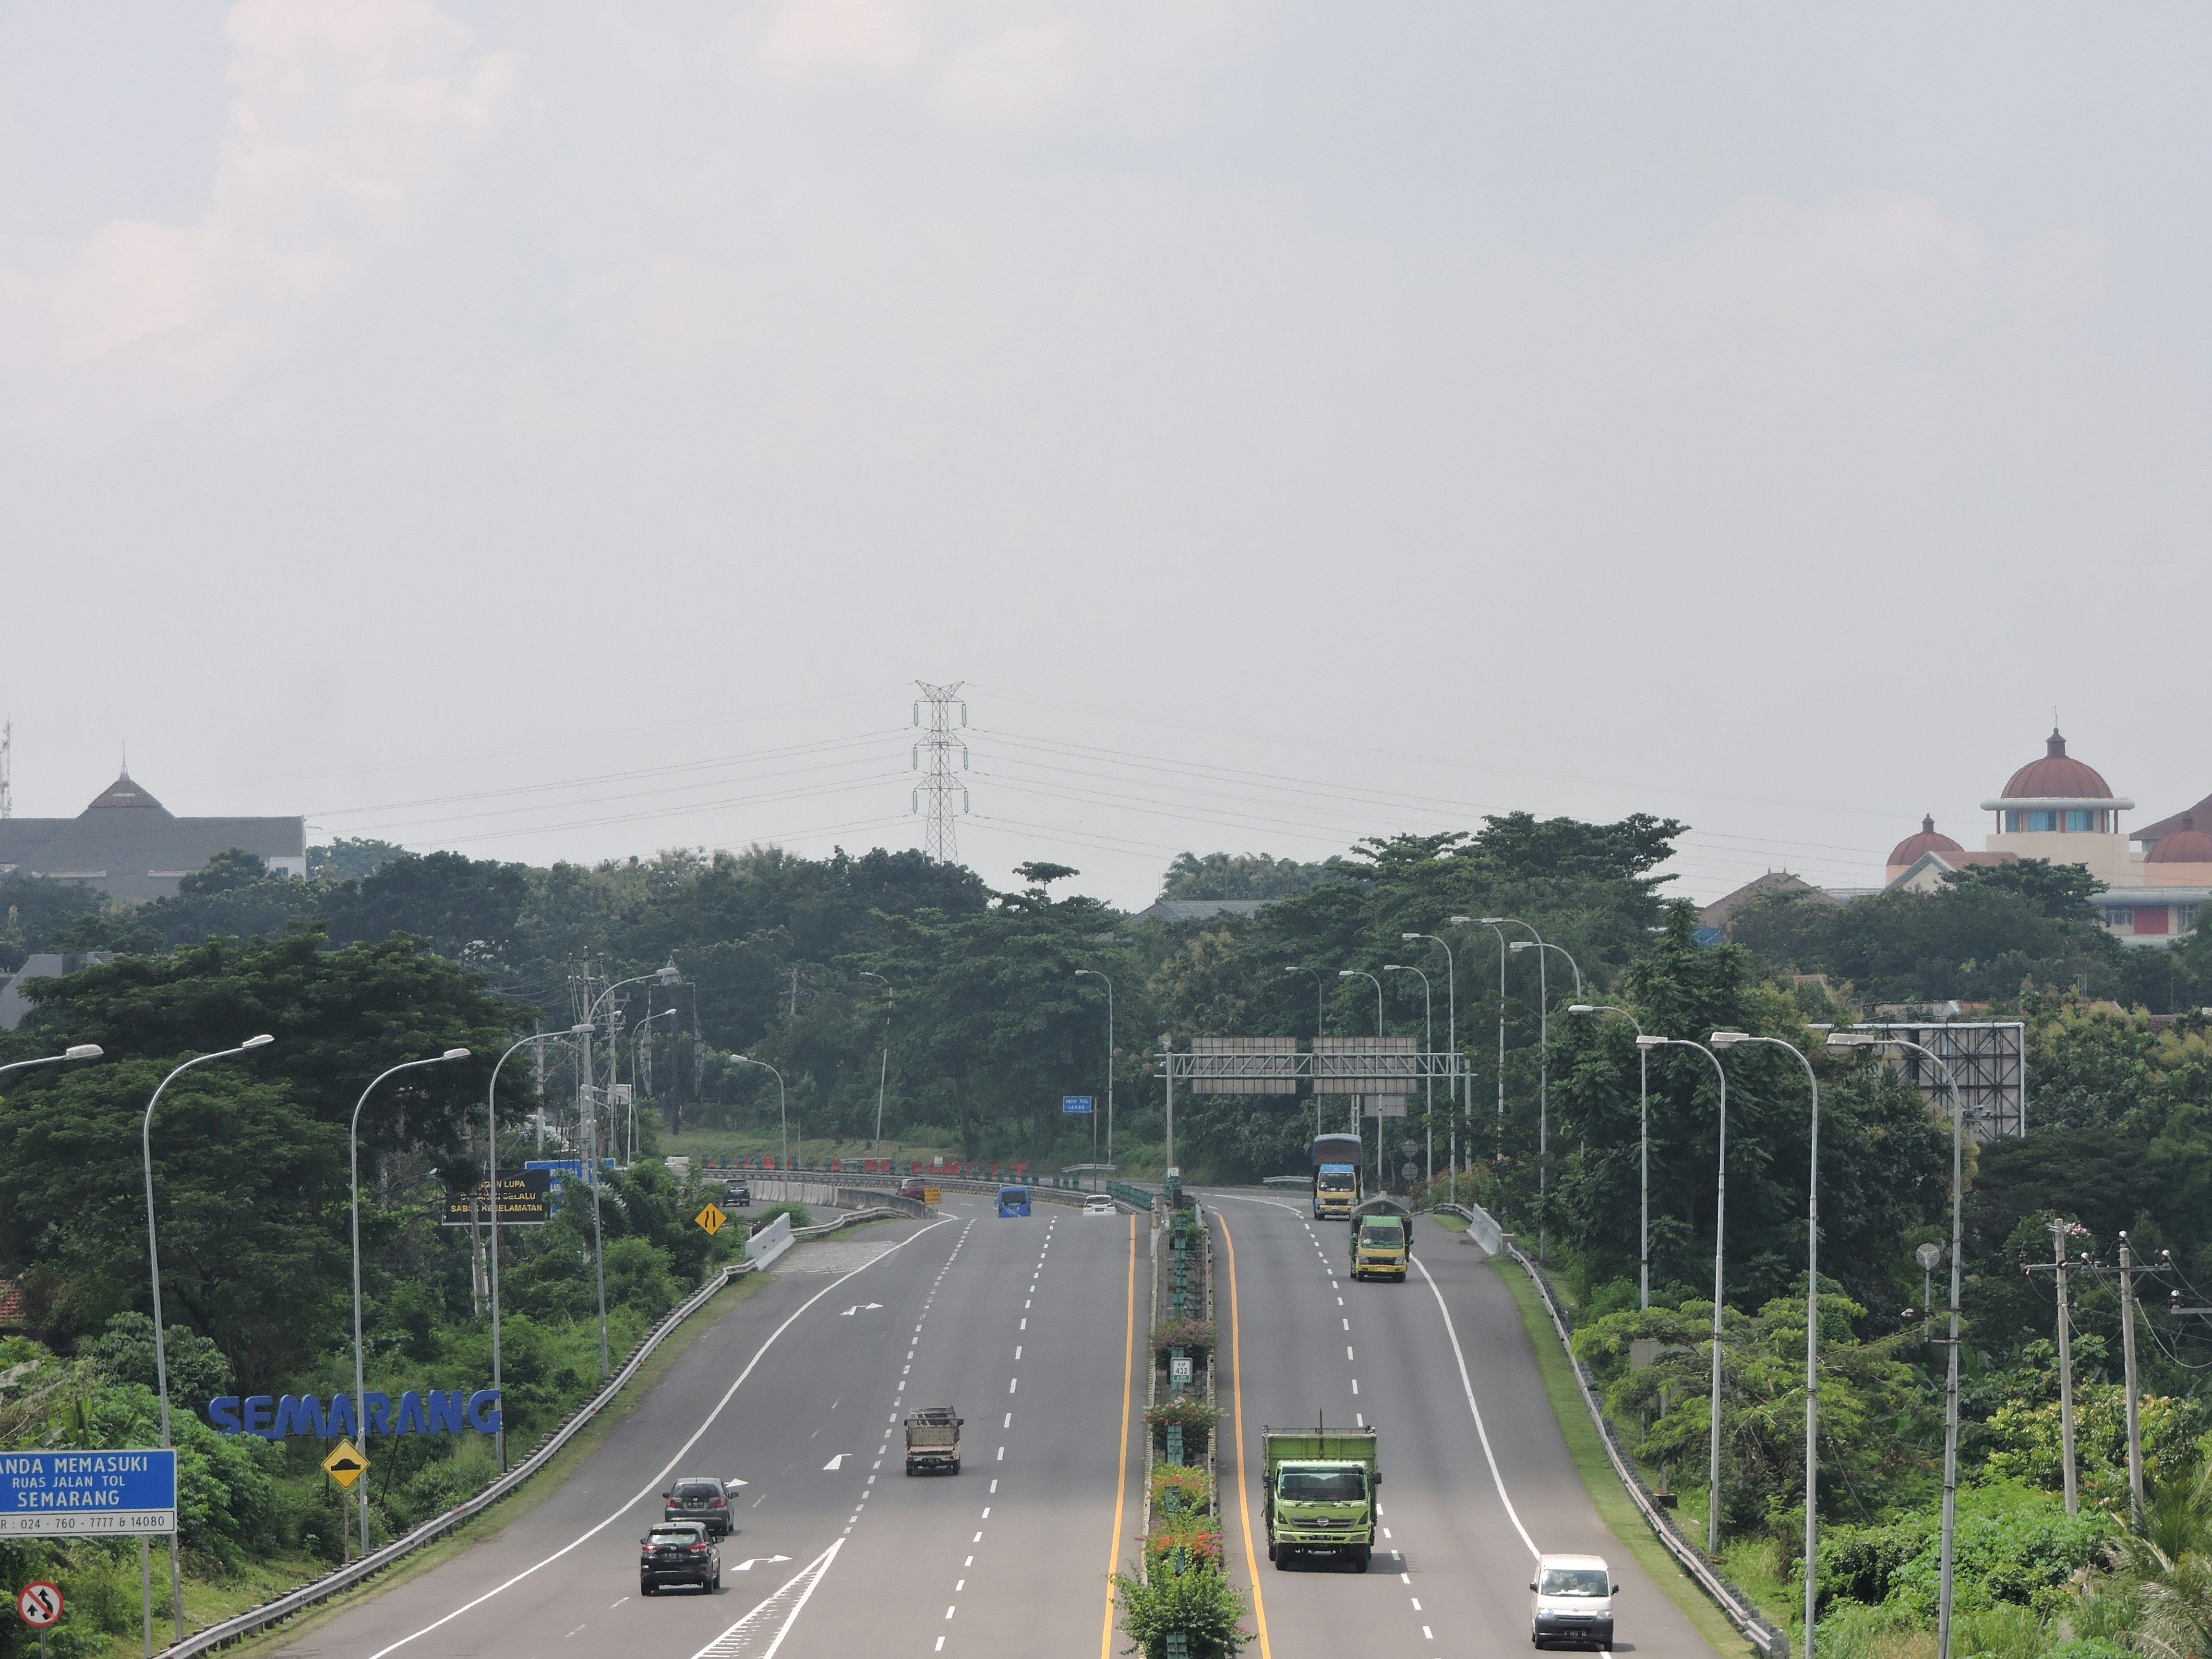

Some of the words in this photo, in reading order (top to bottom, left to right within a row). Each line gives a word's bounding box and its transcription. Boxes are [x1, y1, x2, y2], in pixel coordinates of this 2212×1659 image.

[208, 1389, 502, 1440] SEMARANG
[55, 1456, 147, 1473] MEMASUKI
[12, 1477, 46, 1488] RUAS
[53, 1476, 93, 1487] JALAN
[102, 1475, 125, 1486] TOL
[18, 1490, 120, 1507] SEMARANG
[21, 1519, 40, 1529] 024
[56, 1518, 75, 1528] 760
[90, 1517, 113, 1527] 7777
[131, 1516, 164, 1527] 14080
